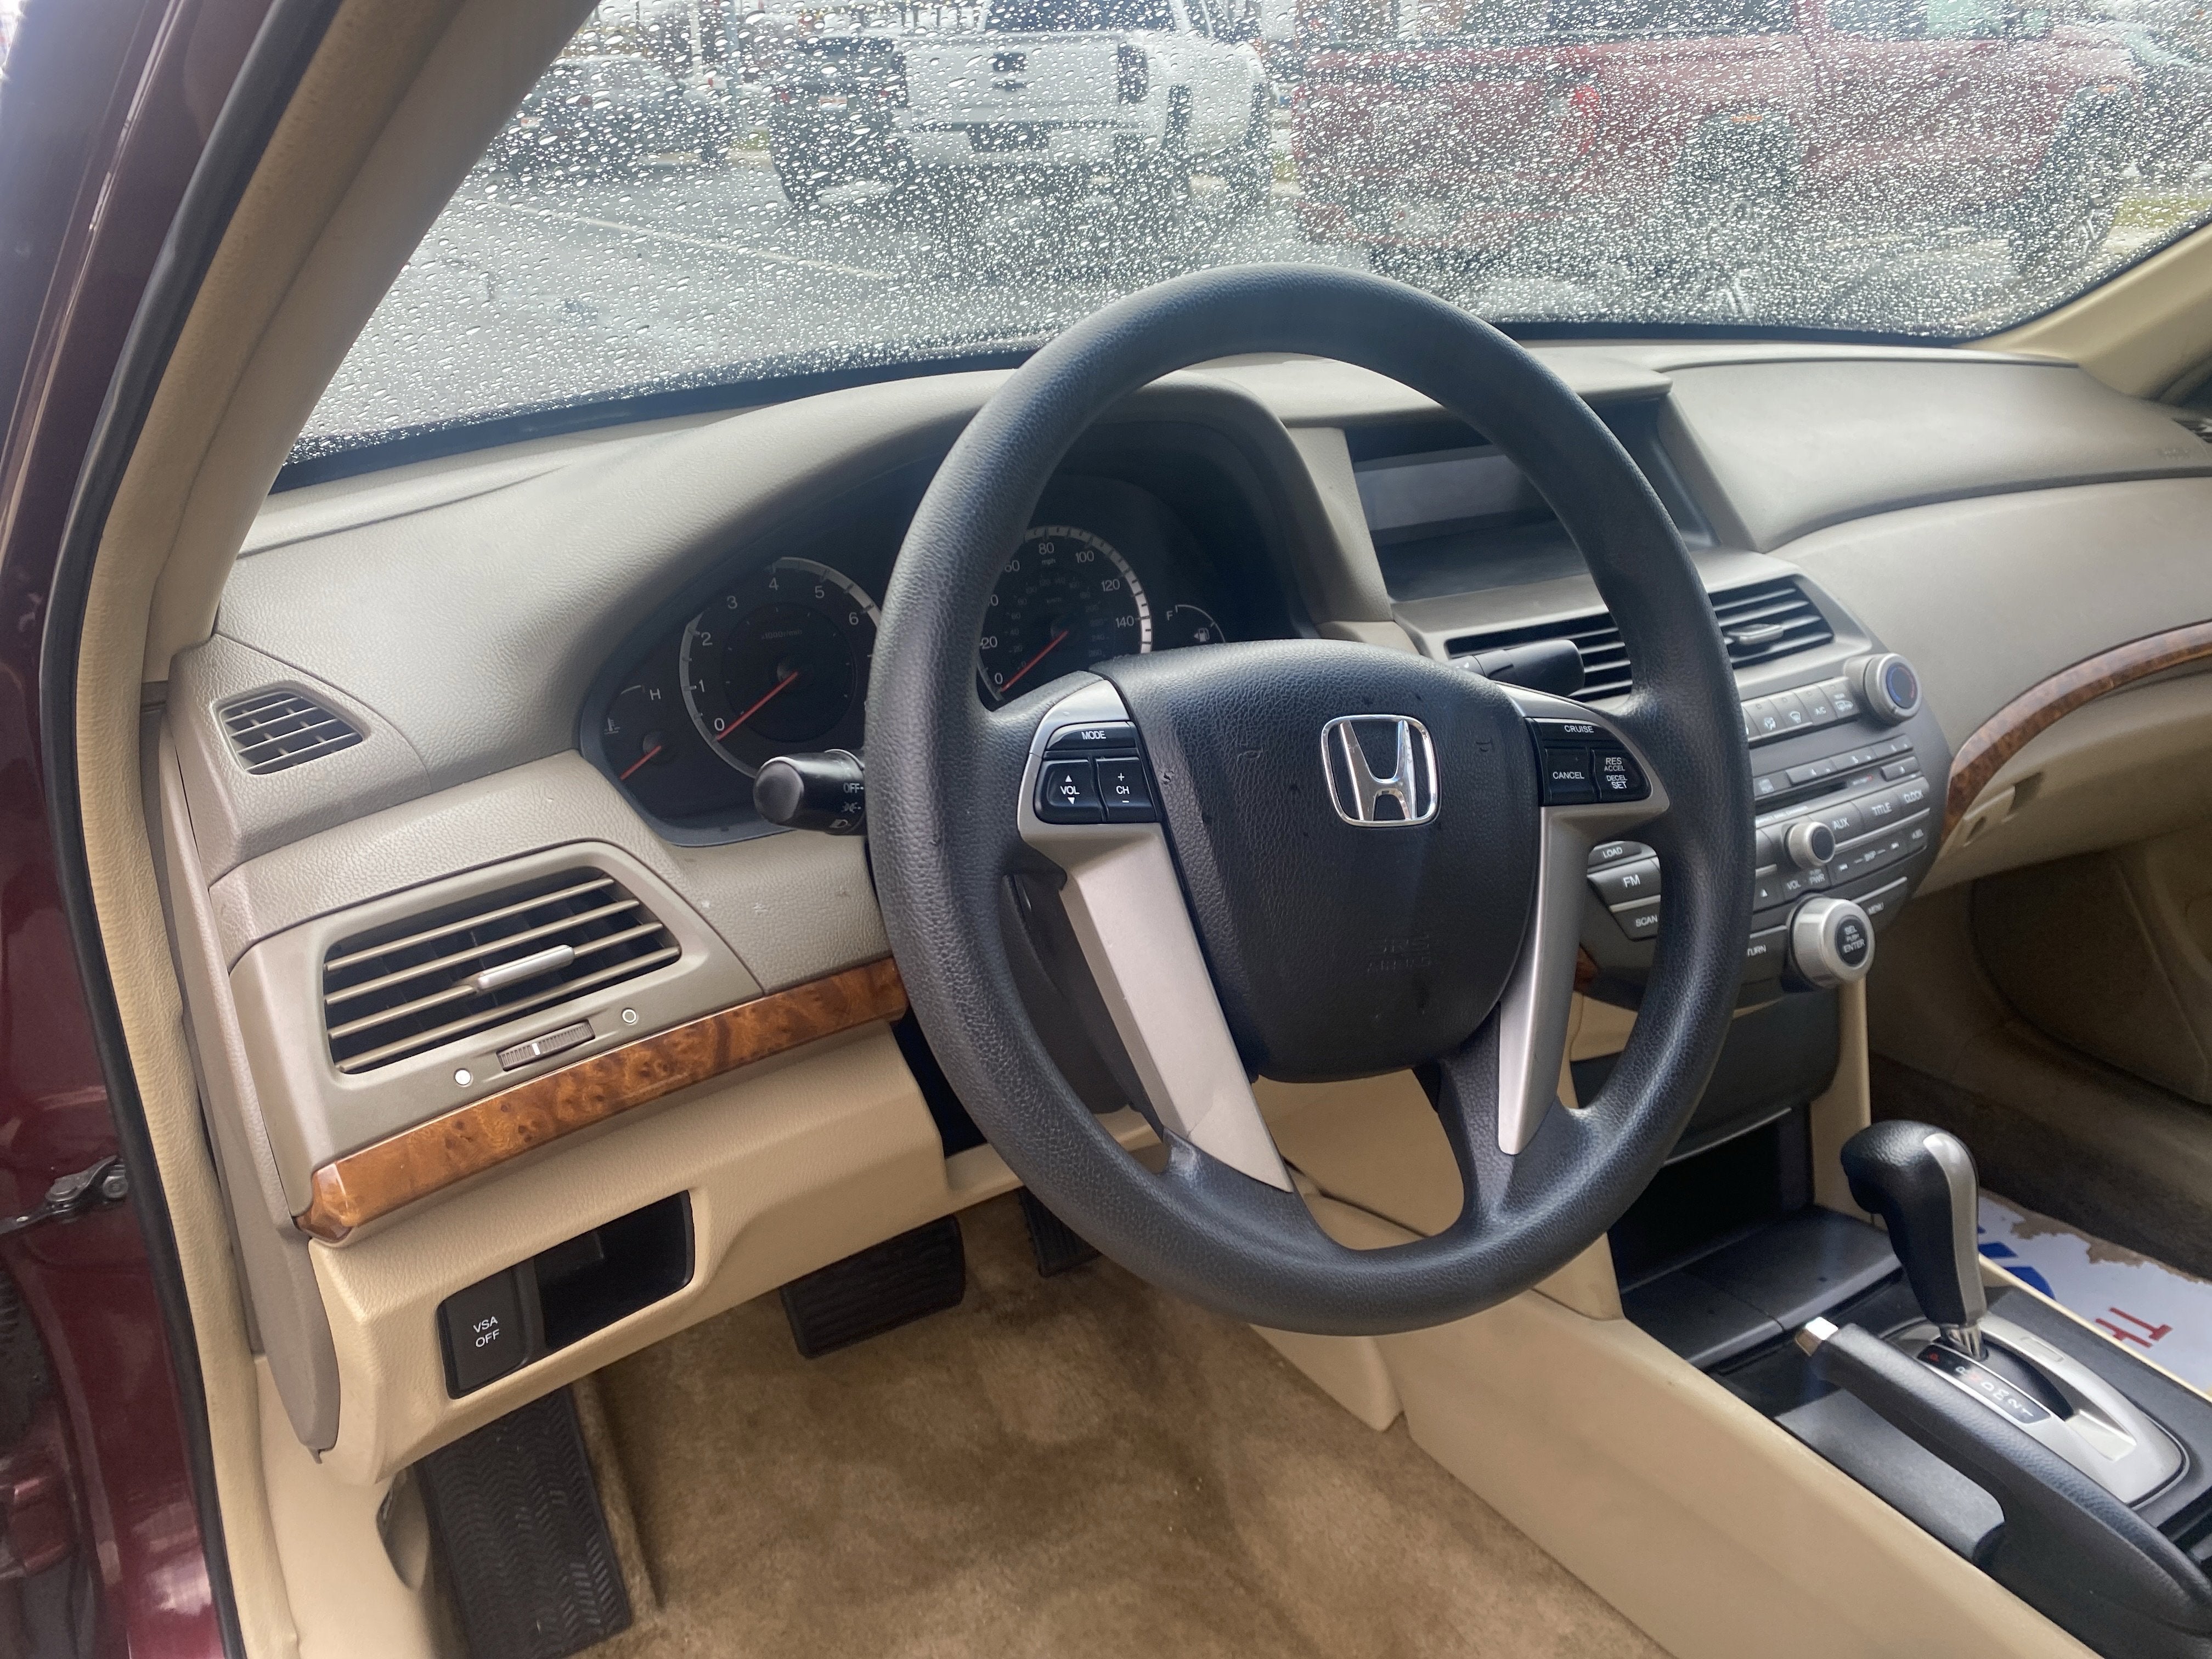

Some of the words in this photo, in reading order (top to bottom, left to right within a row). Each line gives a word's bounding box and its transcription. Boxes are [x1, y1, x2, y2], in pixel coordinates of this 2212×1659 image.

[1039, 542, 1054, 555] 80
[1075, 550, 1094, 563] 100
[769, 578, 779, 592] 4
[1101, 578, 1120, 592] 120
[815, 585, 825, 599] 5
[726, 596, 738, 610] 3
[849, 612, 859, 626] 6
[1115, 615, 1135, 628] 140
[1166, 611, 1173, 620] F
[700, 632, 713, 646] 2
[981, 636, 998, 650] 20
[995, 673, 1003, 685] 0
[698, 680, 705, 692] 1
[650, 689, 661, 701] H
[714, 718, 725, 732] 0
[1081, 731, 1106, 740] MODE
[1605, 757, 1622, 765] RES
[843, 782, 860, 793] OFF
[1060, 786, 1080, 794] VOL
[1116, 786, 1130, 794] CH
[1871, 802, 1892, 816] TITLE
[1833, 817, 1849, 830] AUX
[1602, 847, 1623, 859] LOAD
[1623, 874, 1640, 888] FM
[1787, 880, 1801, 890] VOL
[1635, 915, 1658, 927] SCAN
[1843, 939, 1865, 953] ENTER
[473, 1316, 498, 1333] VSA
[475, 1329, 500, 1347] OFF
